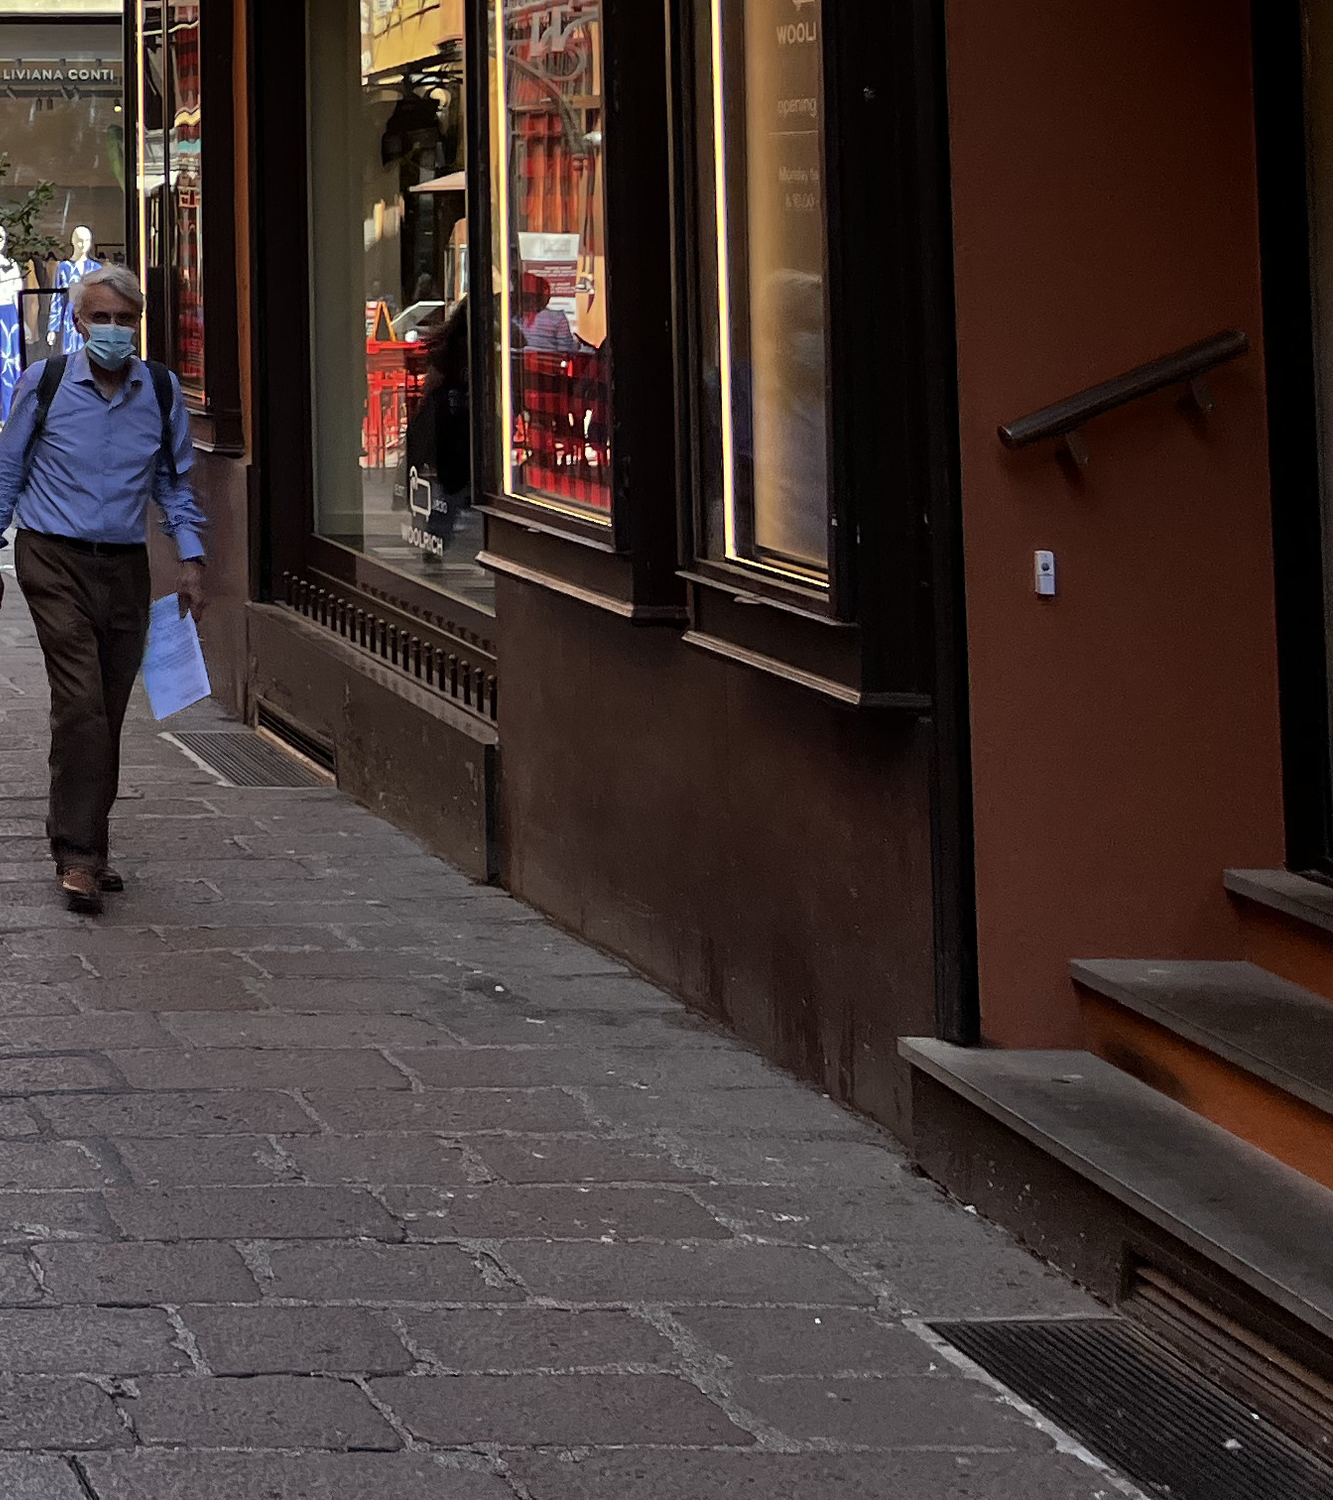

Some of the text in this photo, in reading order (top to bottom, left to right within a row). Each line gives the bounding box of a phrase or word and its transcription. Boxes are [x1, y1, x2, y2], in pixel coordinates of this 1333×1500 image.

[3, 68, 114, 81] LIVIANA CONTI
[400, 523, 443, 556] WOOLRICH
